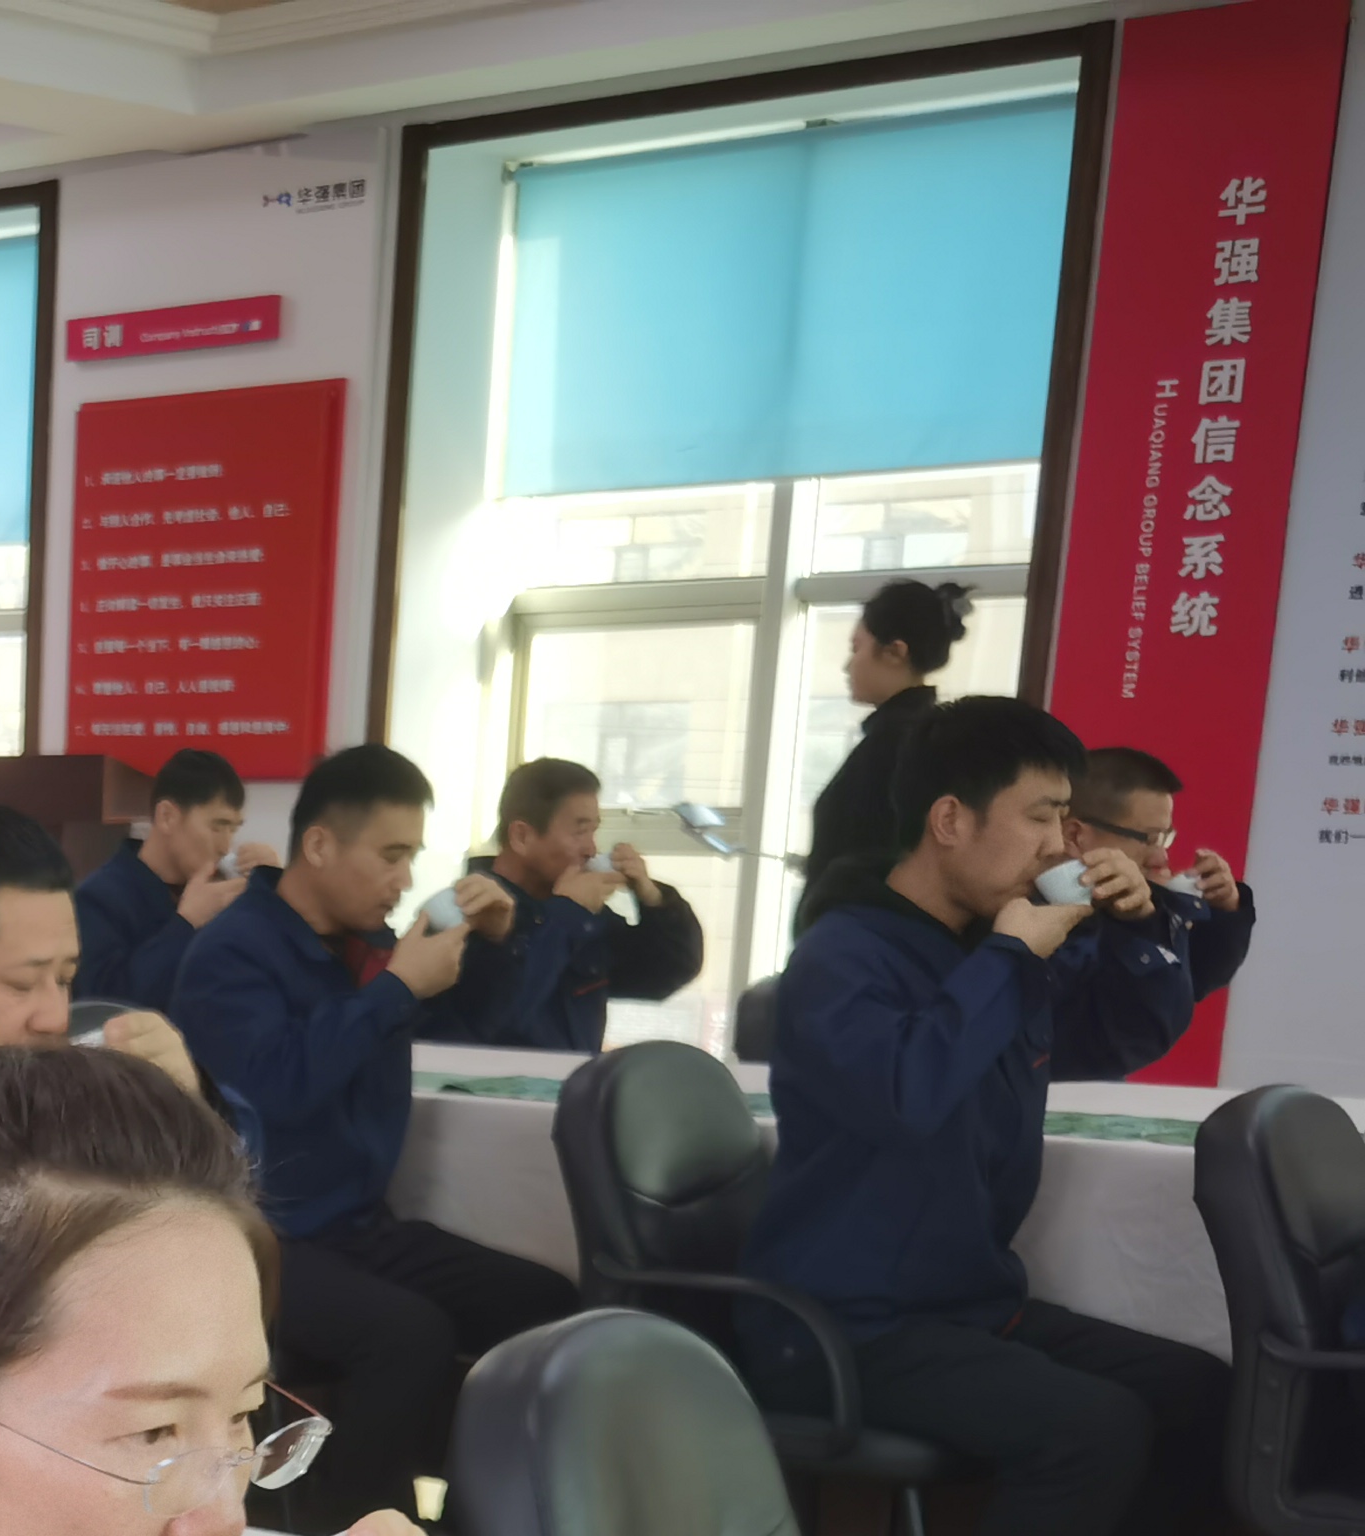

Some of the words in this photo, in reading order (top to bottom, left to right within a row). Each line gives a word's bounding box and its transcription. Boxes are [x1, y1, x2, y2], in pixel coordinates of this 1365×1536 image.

[1145, 379, 1180, 489] HUAQIANG
[1169, 176, 1268, 638] 华强集团信念系统
[1137, 493, 1159, 558] GROUP
[1130, 562, 1151, 621] BELIEF
[1121, 626, 1144, 699] SYSTEM
[1321, 797, 1365, 816] 华强
